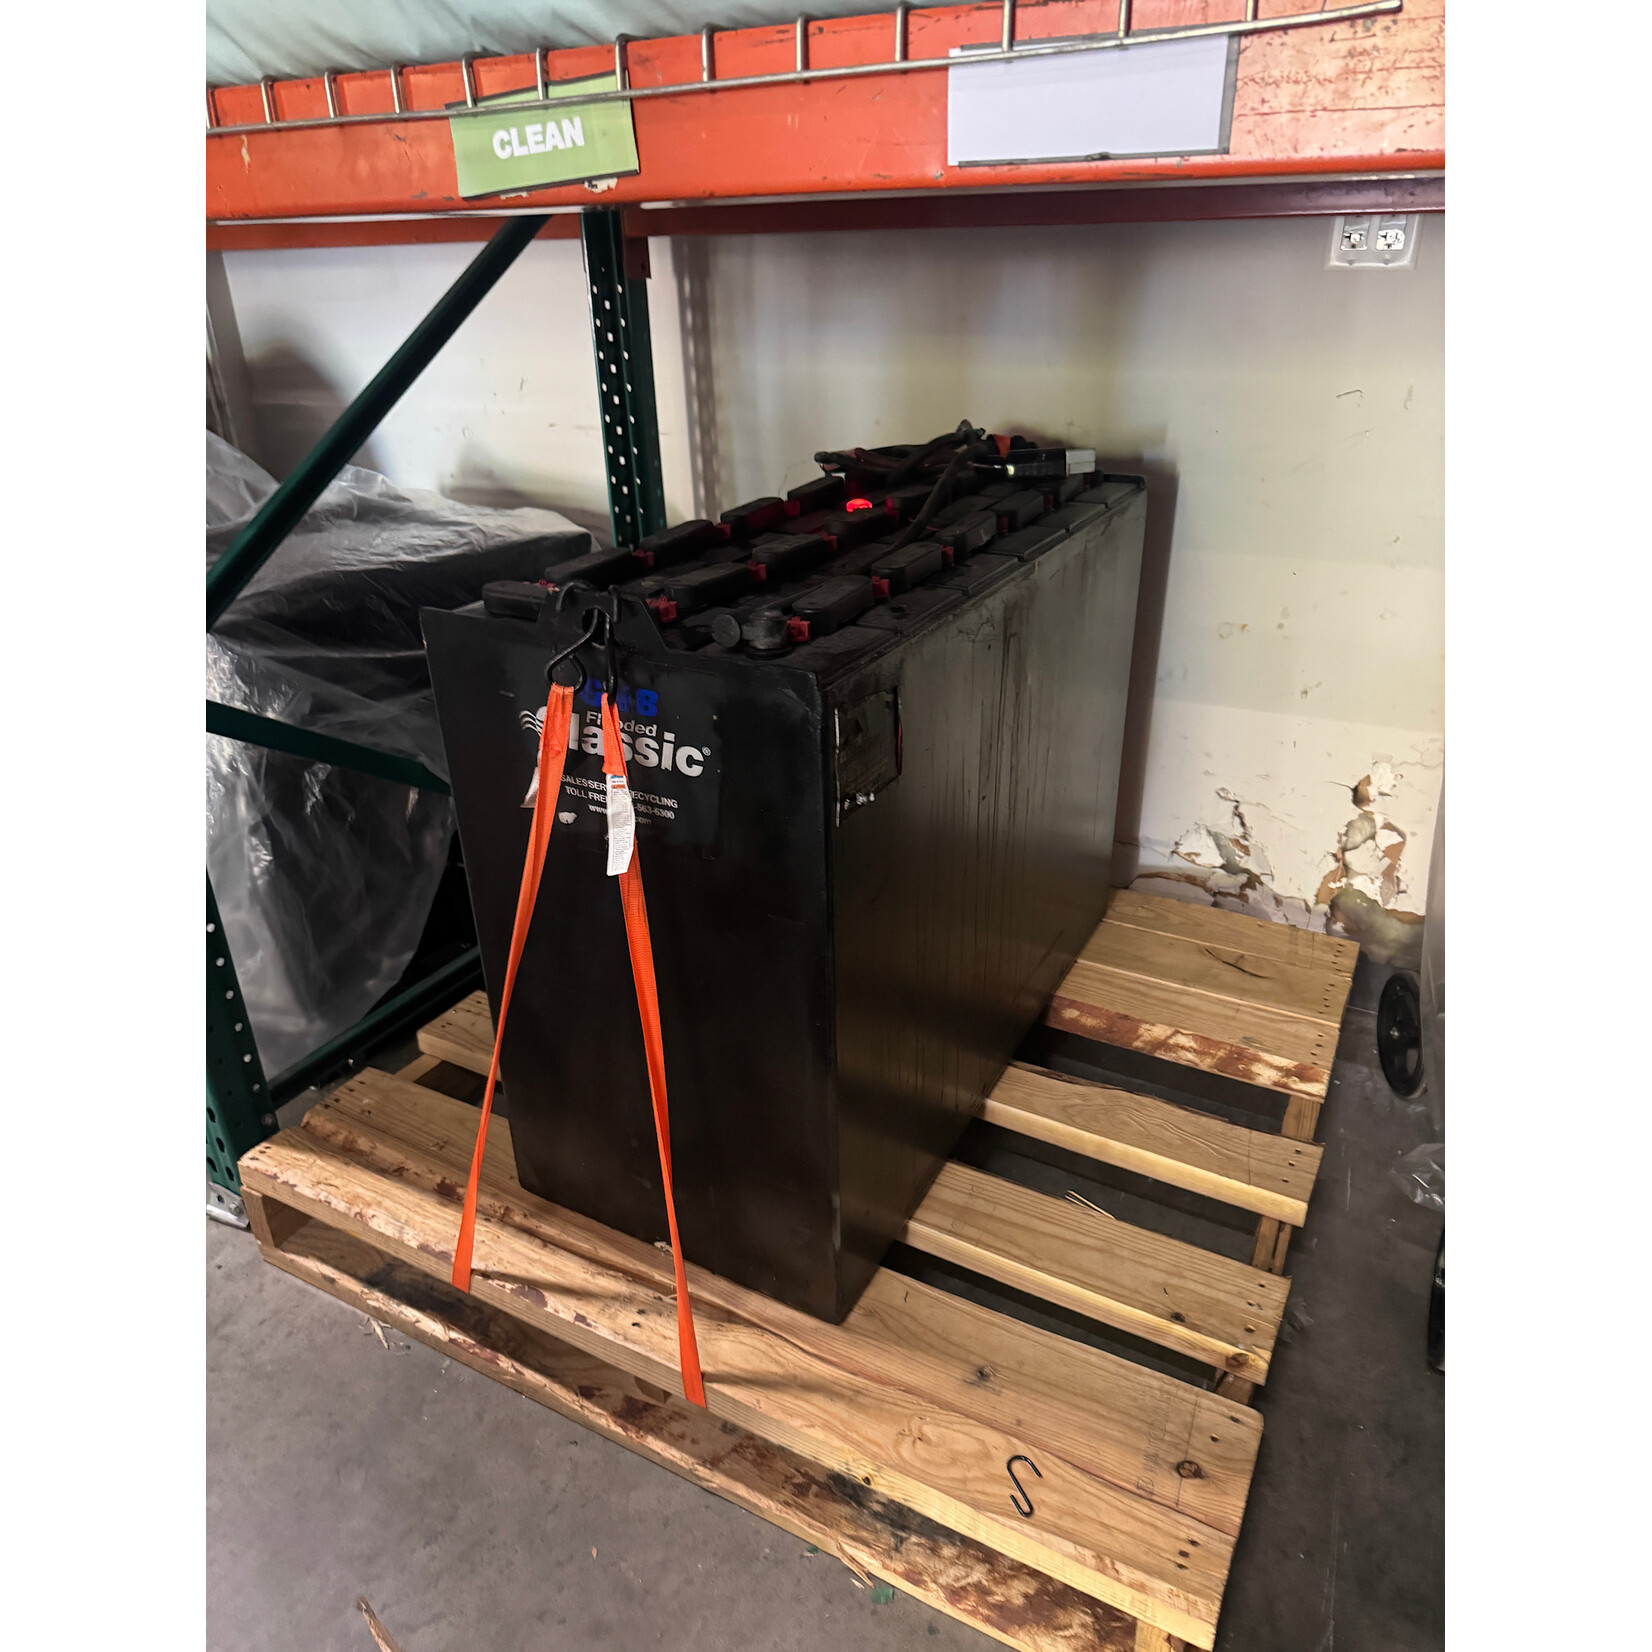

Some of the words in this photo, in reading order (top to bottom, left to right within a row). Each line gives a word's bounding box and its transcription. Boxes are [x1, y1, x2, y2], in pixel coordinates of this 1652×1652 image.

[492, 116, 585, 159] CLEAN
[586, 710, 658, 737] Flded
[565, 785, 588, 799] TOLL
[588, 791, 607, 803] FRE
